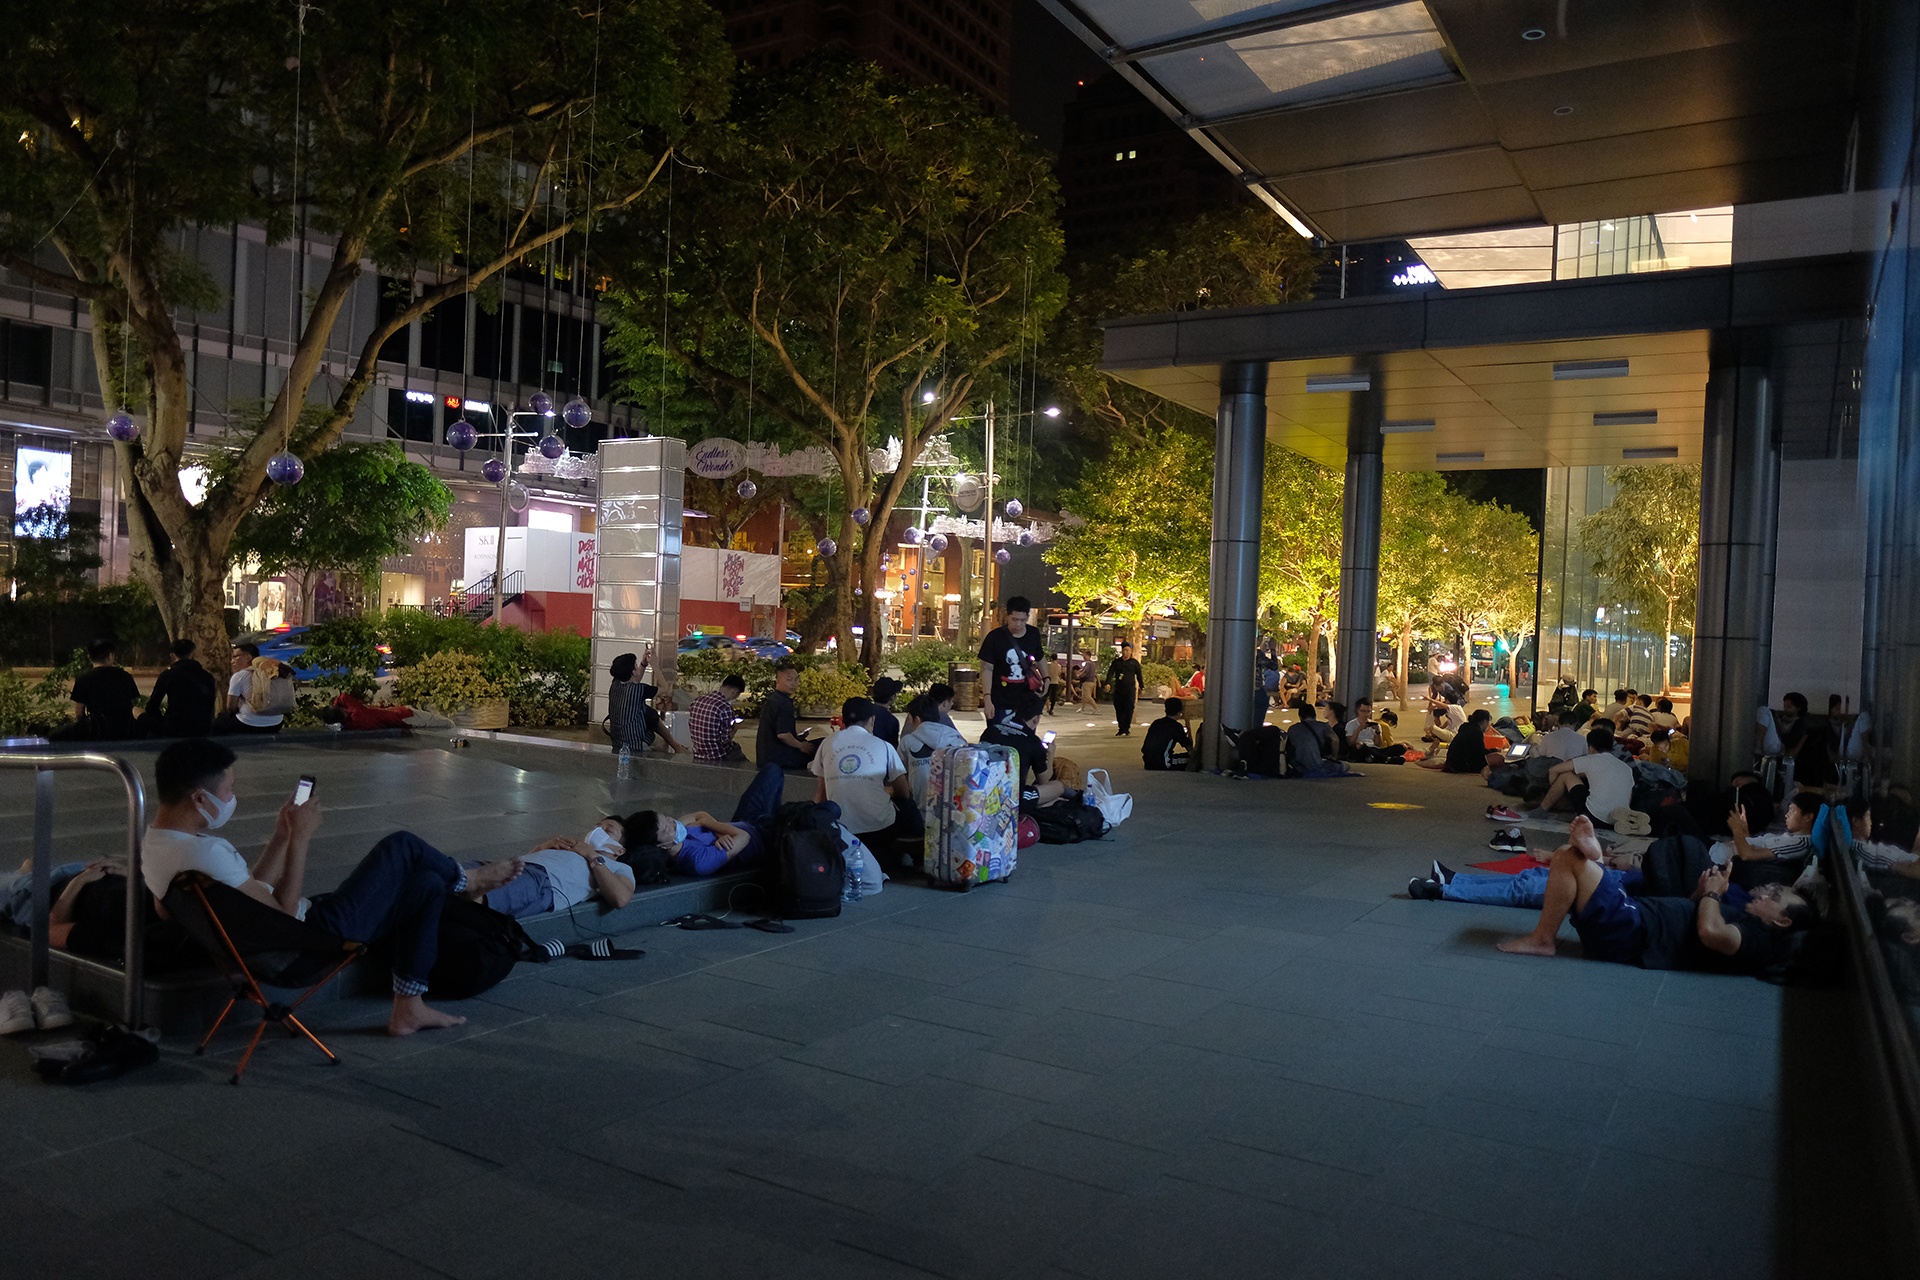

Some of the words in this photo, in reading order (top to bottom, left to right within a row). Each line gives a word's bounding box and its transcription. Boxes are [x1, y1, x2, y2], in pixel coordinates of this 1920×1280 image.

[695, 446, 729, 461] Endless
[696, 460, 734, 472] Wonder
[384, 558, 439, 572] MICHAEL
[445, 562, 461, 574] KO
